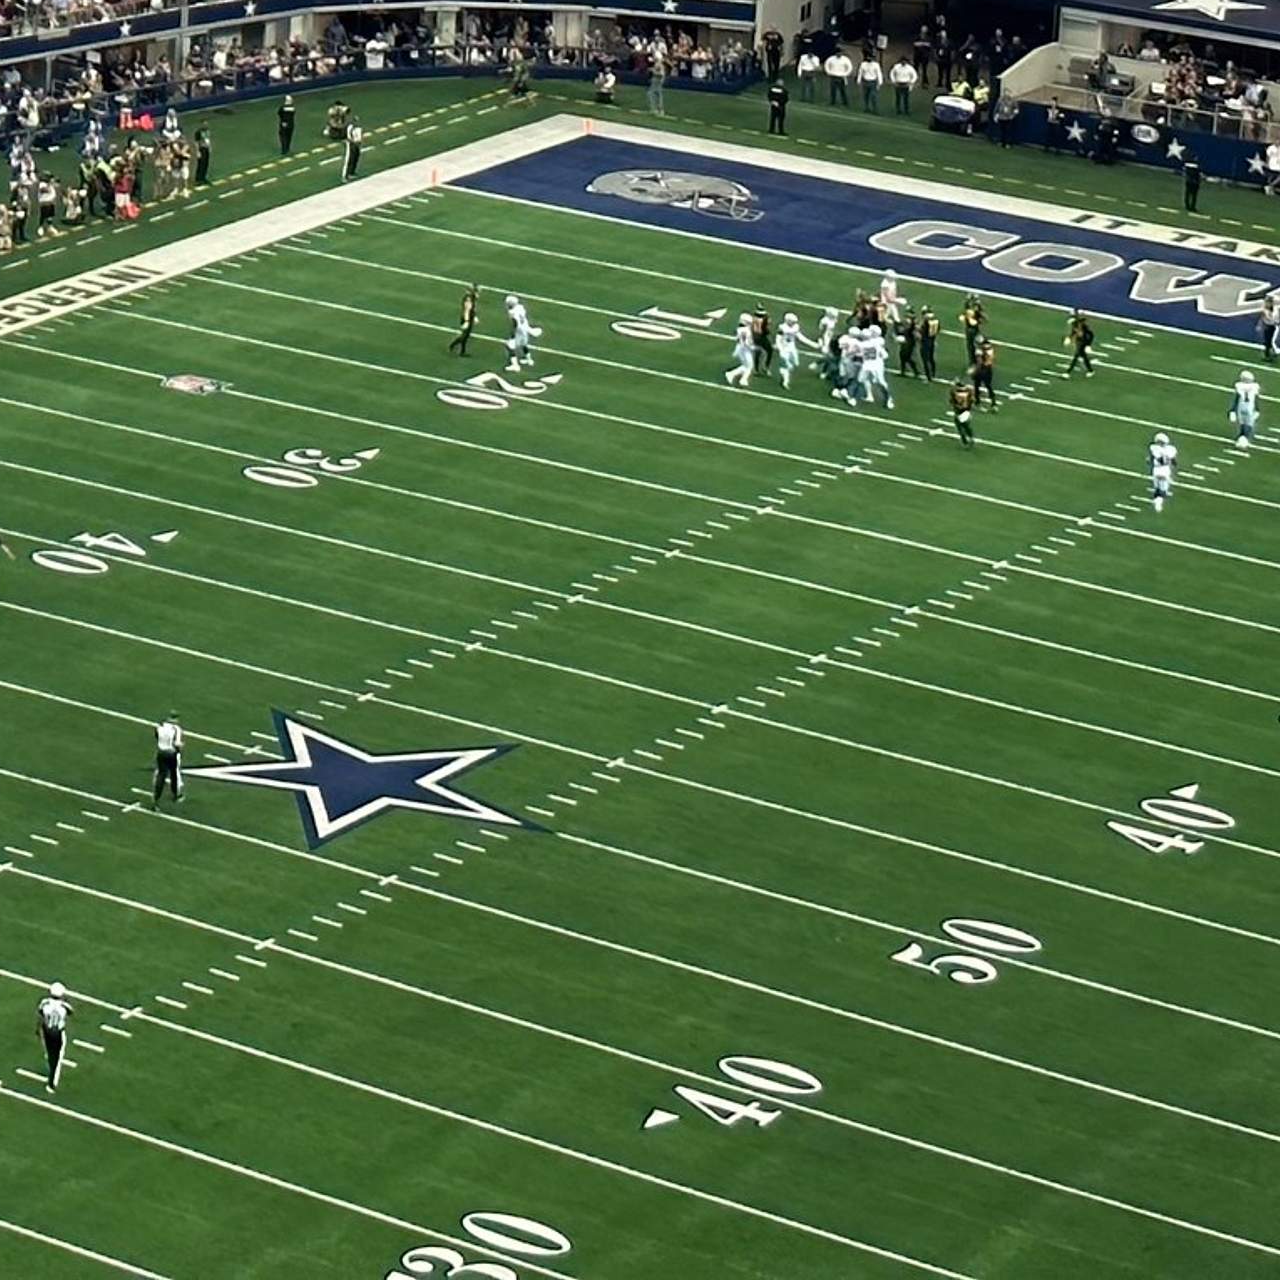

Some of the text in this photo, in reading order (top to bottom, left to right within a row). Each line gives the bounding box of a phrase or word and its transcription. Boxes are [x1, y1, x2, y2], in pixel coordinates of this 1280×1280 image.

[1070, 214, 1138, 230] IT
[437, 372, 547, 409] 20
[243, 448, 361, 487] 30
[31, 531, 147, 575] 40
[1107, 796, 1235, 855] 40
[891, 918, 1042, 985] 50
[674, 1055, 823, 1129] 40
[401, 1212, 572, 1280] 30
